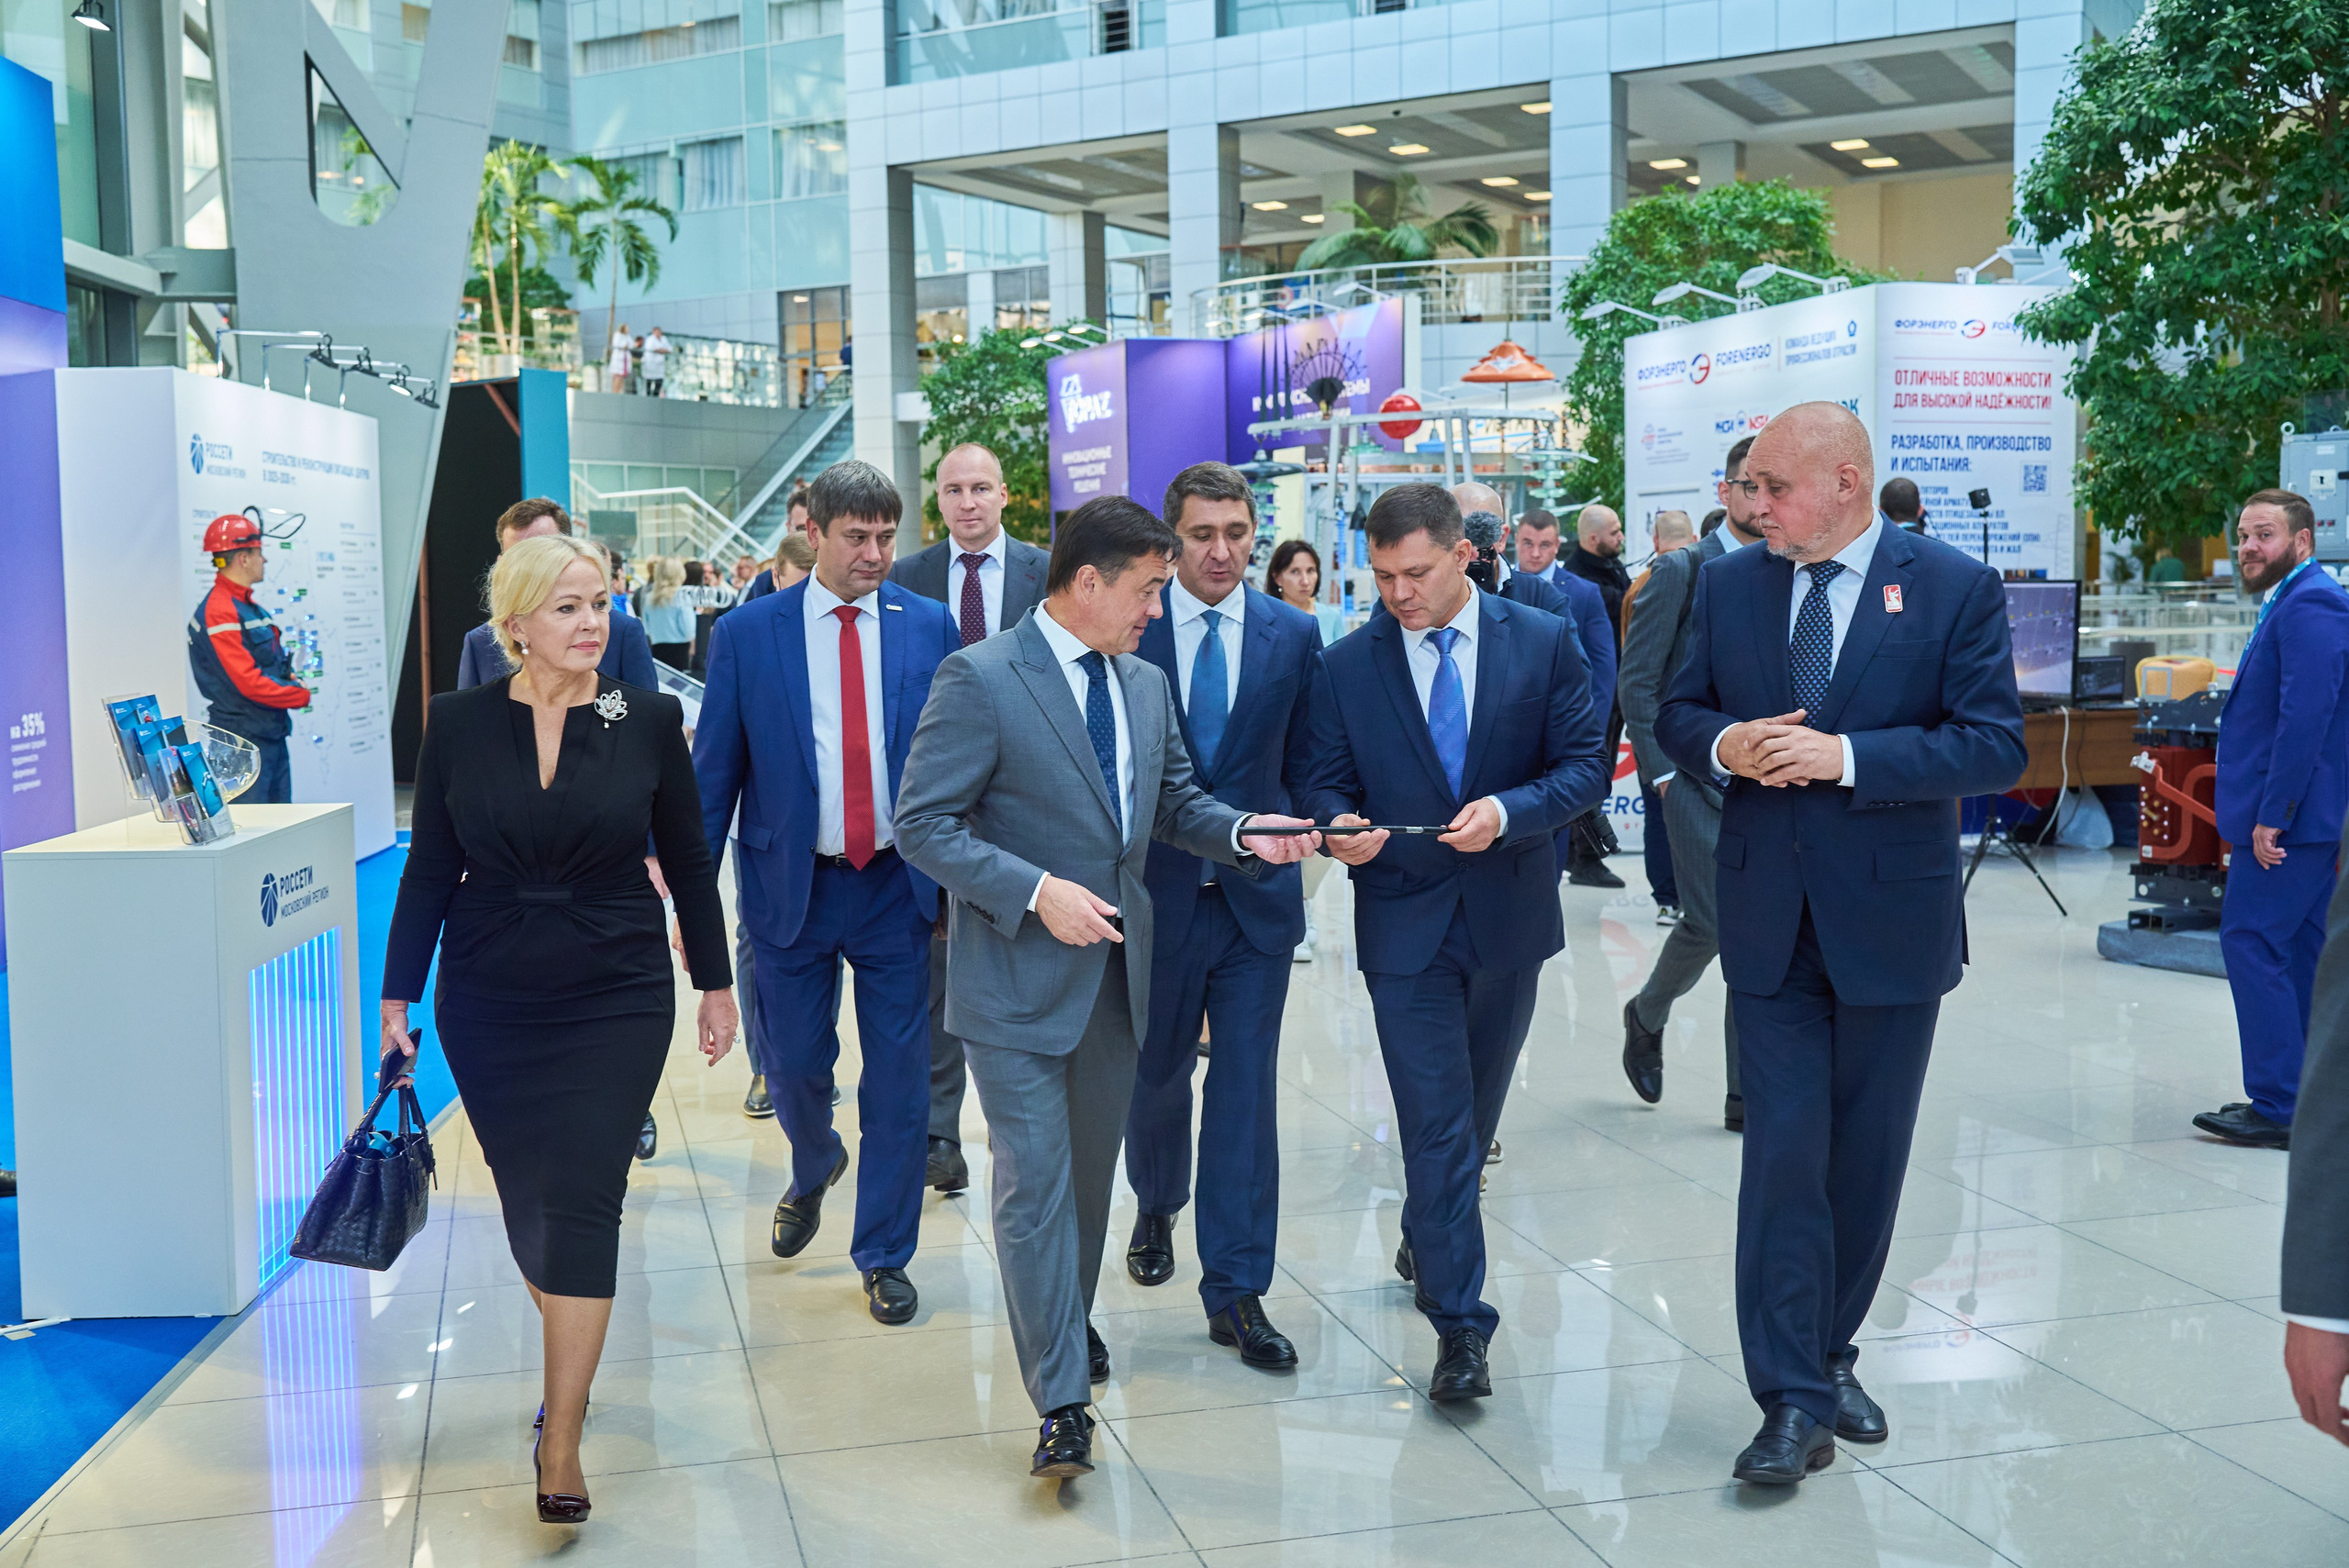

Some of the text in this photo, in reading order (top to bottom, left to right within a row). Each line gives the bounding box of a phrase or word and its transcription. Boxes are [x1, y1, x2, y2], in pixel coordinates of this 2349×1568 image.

[1895, 319, 1957, 330] ФОРЭНЕРГО
[1716, 343, 1772, 367] FORENERGO
[1638, 360, 1687, 381] ФОРЭНЕРГО
[1895, 370, 2052, 388] ОТЛИЧНЫЕ ВОЗМОЖНОСТИ
[1894, 392, 2052, 409] ДЛЯ ВЫСОКОЙ НАДЁЖНОСТИ!
[1891, 434, 2052, 452] РАЗРАБОТКА, ПРОИЗВОДСТВО
[1891, 457, 1972, 473] И ИСПЫТАНИЯ:
[21, 711, 45, 738] 35%
[280, 865, 313, 897] РОССЕТИ
[280, 885, 329, 918] МОСКОВСКИЙ РЕГИОН
